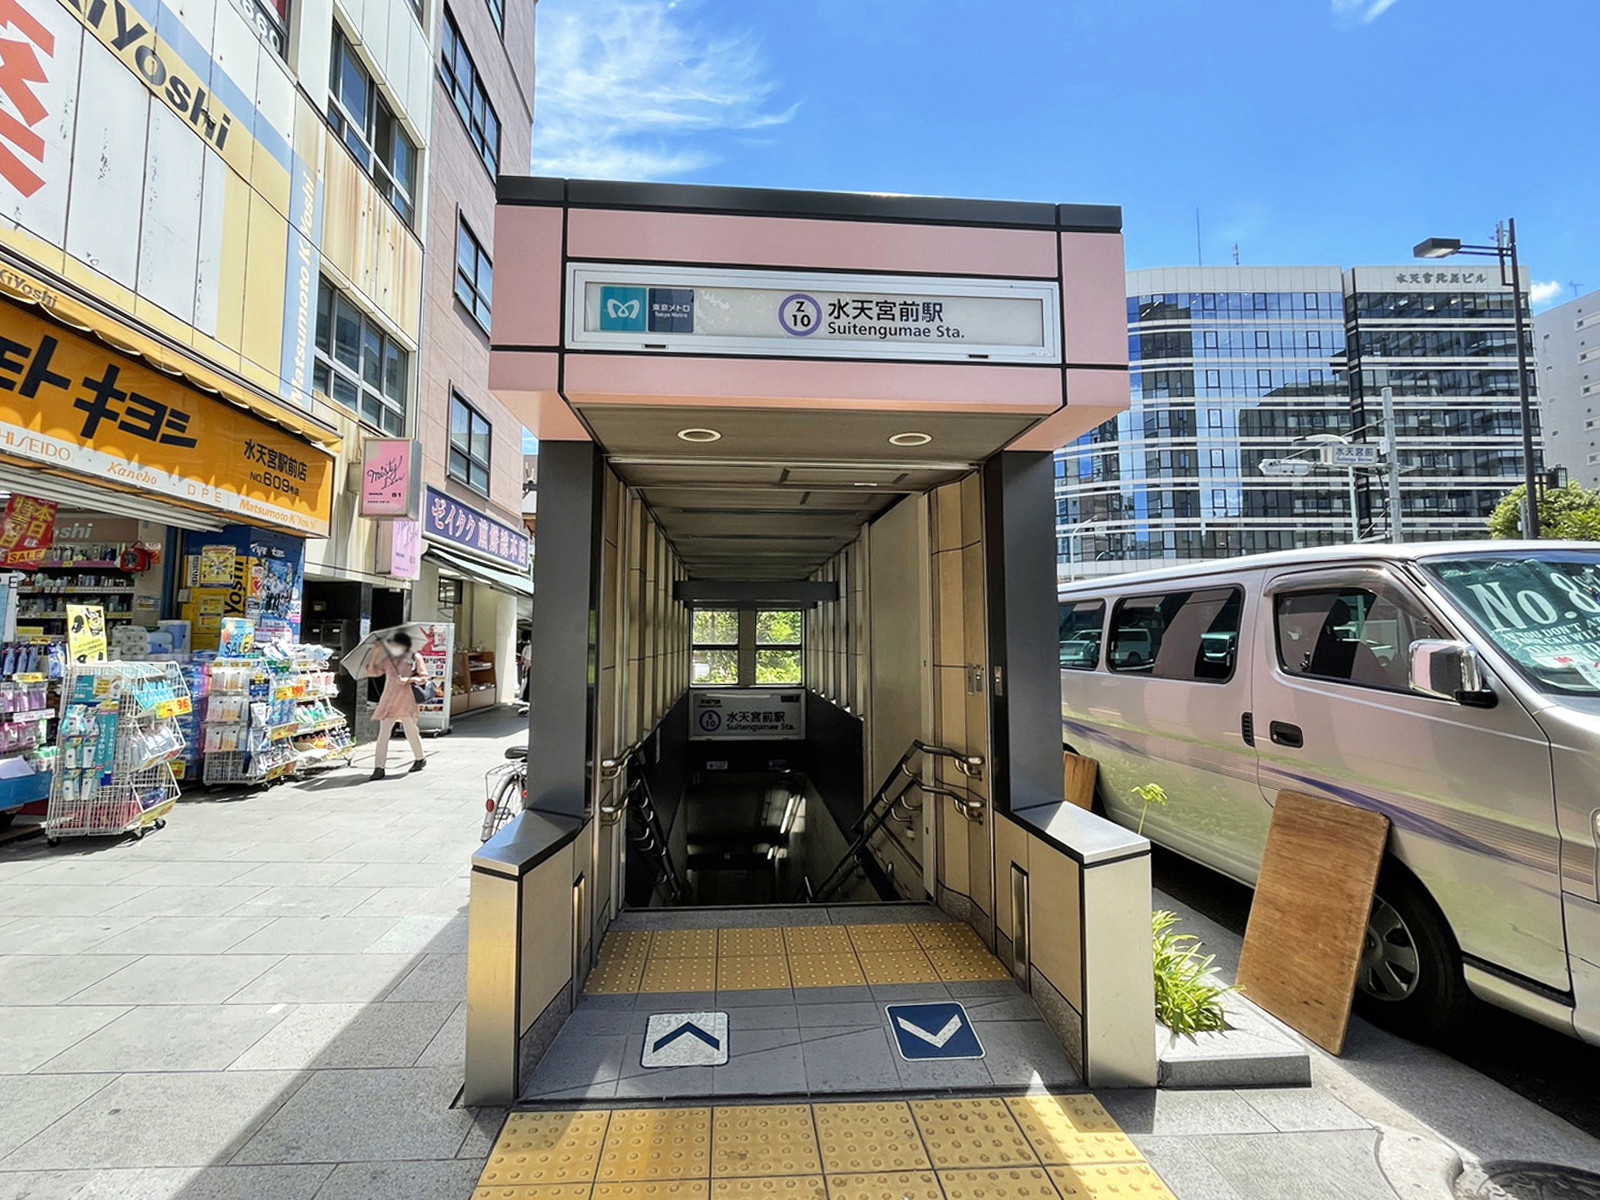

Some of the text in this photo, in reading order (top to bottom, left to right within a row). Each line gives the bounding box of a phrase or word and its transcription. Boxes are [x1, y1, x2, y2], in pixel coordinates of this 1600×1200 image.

[795, 301, 805, 312] Z
[828, 298, 944, 323] 水天宮前駅
[792, 314, 812, 327] 10
[828, 322, 965, 340] Suitengumae Sta.
[244, 438, 308, 482] 水天宮駅前店
[107, 461, 158, 485] Kanebo
[239, 499, 289, 522] Matsumoto
[53, 523, 93, 540] shi
[8, 549, 43, 563] SALE
[1541, 622, 1582, 637] DON'T
[1543, 635, 1571, 645] CAR
[727, 711, 786, 723] 水天宮前駅
